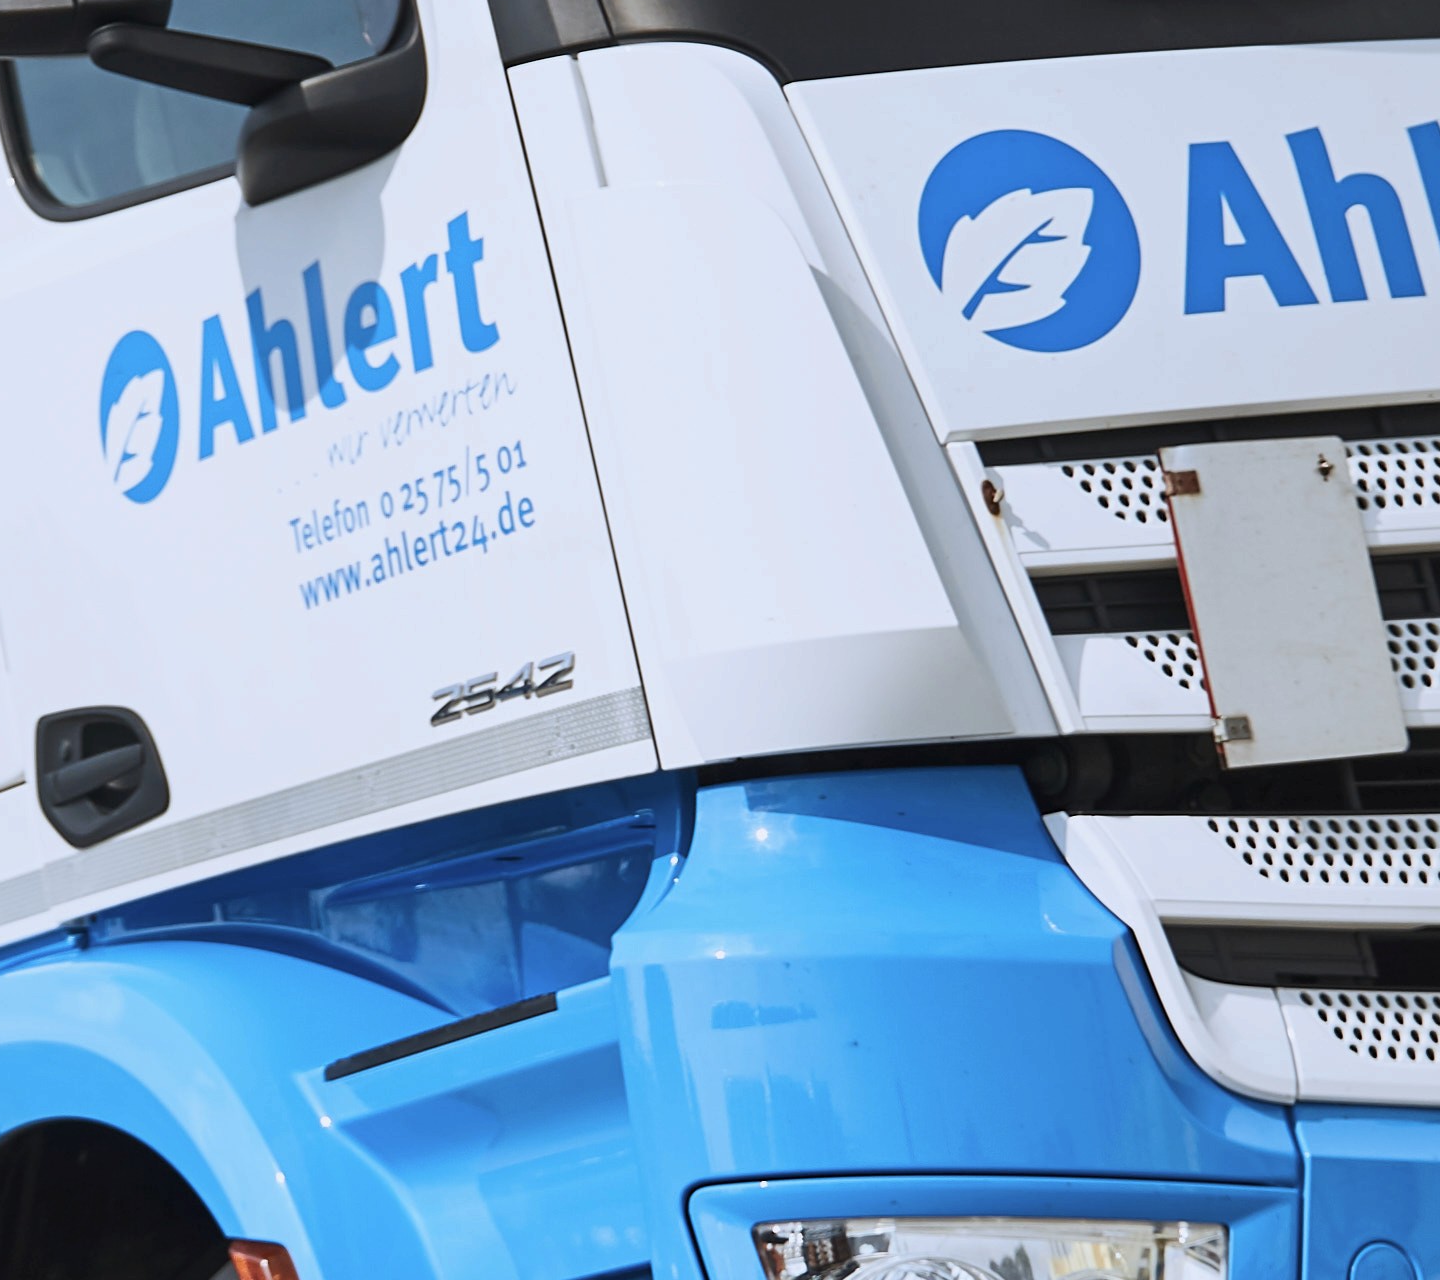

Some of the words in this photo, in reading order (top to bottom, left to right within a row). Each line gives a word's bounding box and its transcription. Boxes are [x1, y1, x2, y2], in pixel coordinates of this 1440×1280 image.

[198, 210, 500, 461] Ahlert
[382, 372, 517, 449] verwerten
[290, 500, 370, 553] Telefon
[380, 491, 394, 518] 0
[400, 477, 428, 515] 25
[497, 439, 527, 474] 01
[299, 490, 536, 610] www.ahlert24.de
[430, 651, 576, 728] 2542
